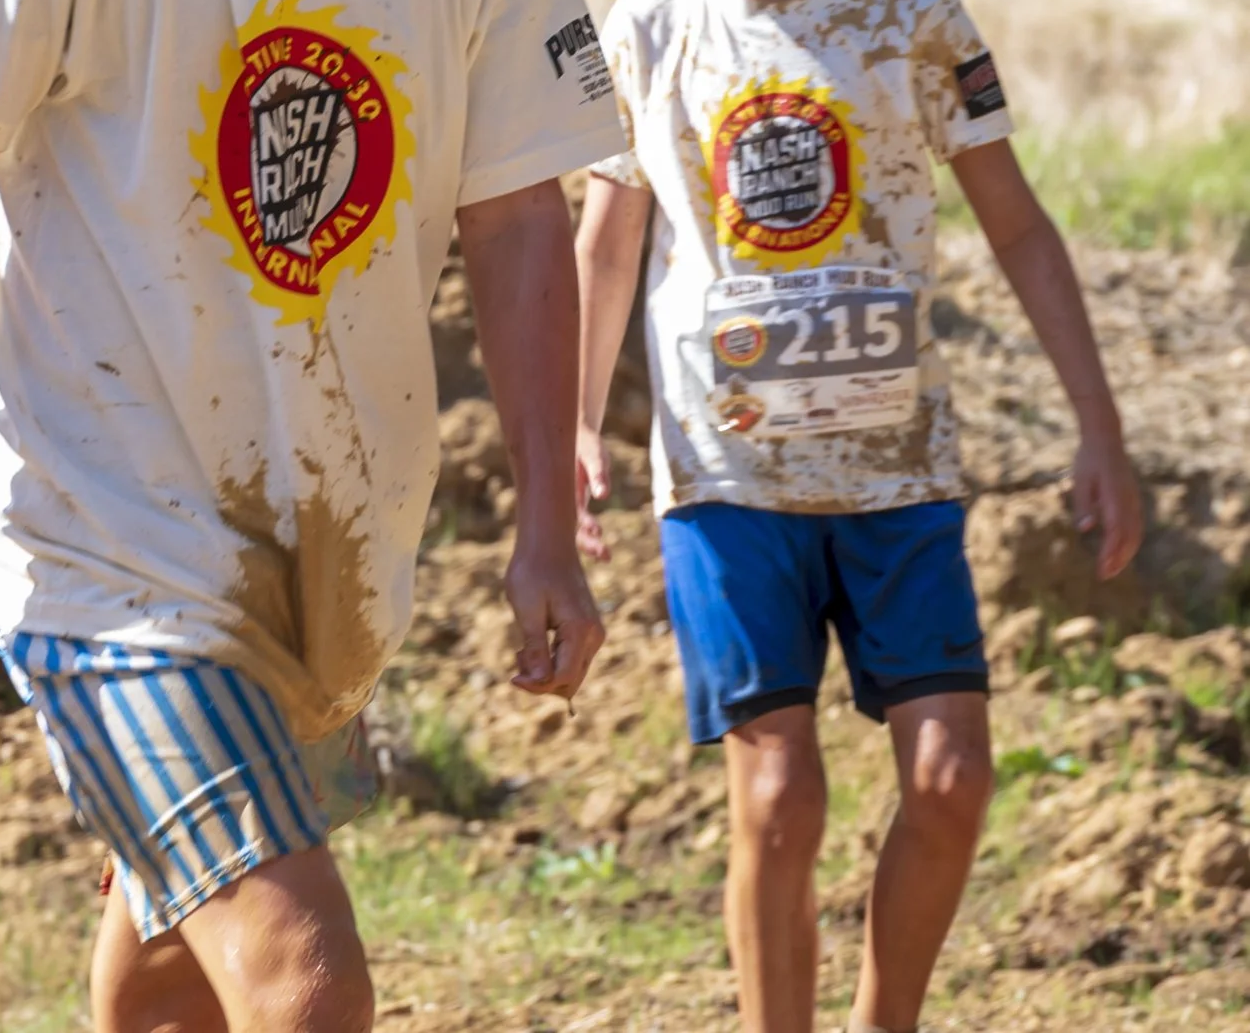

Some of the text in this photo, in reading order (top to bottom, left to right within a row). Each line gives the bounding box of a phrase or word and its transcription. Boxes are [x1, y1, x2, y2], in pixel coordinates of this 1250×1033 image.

[246, 36, 382, 123] TIVE 20-30
[258, 93, 336, 162] NSH
[741, 129, 817, 173] NASH
[776, 301, 902, 365] 215
